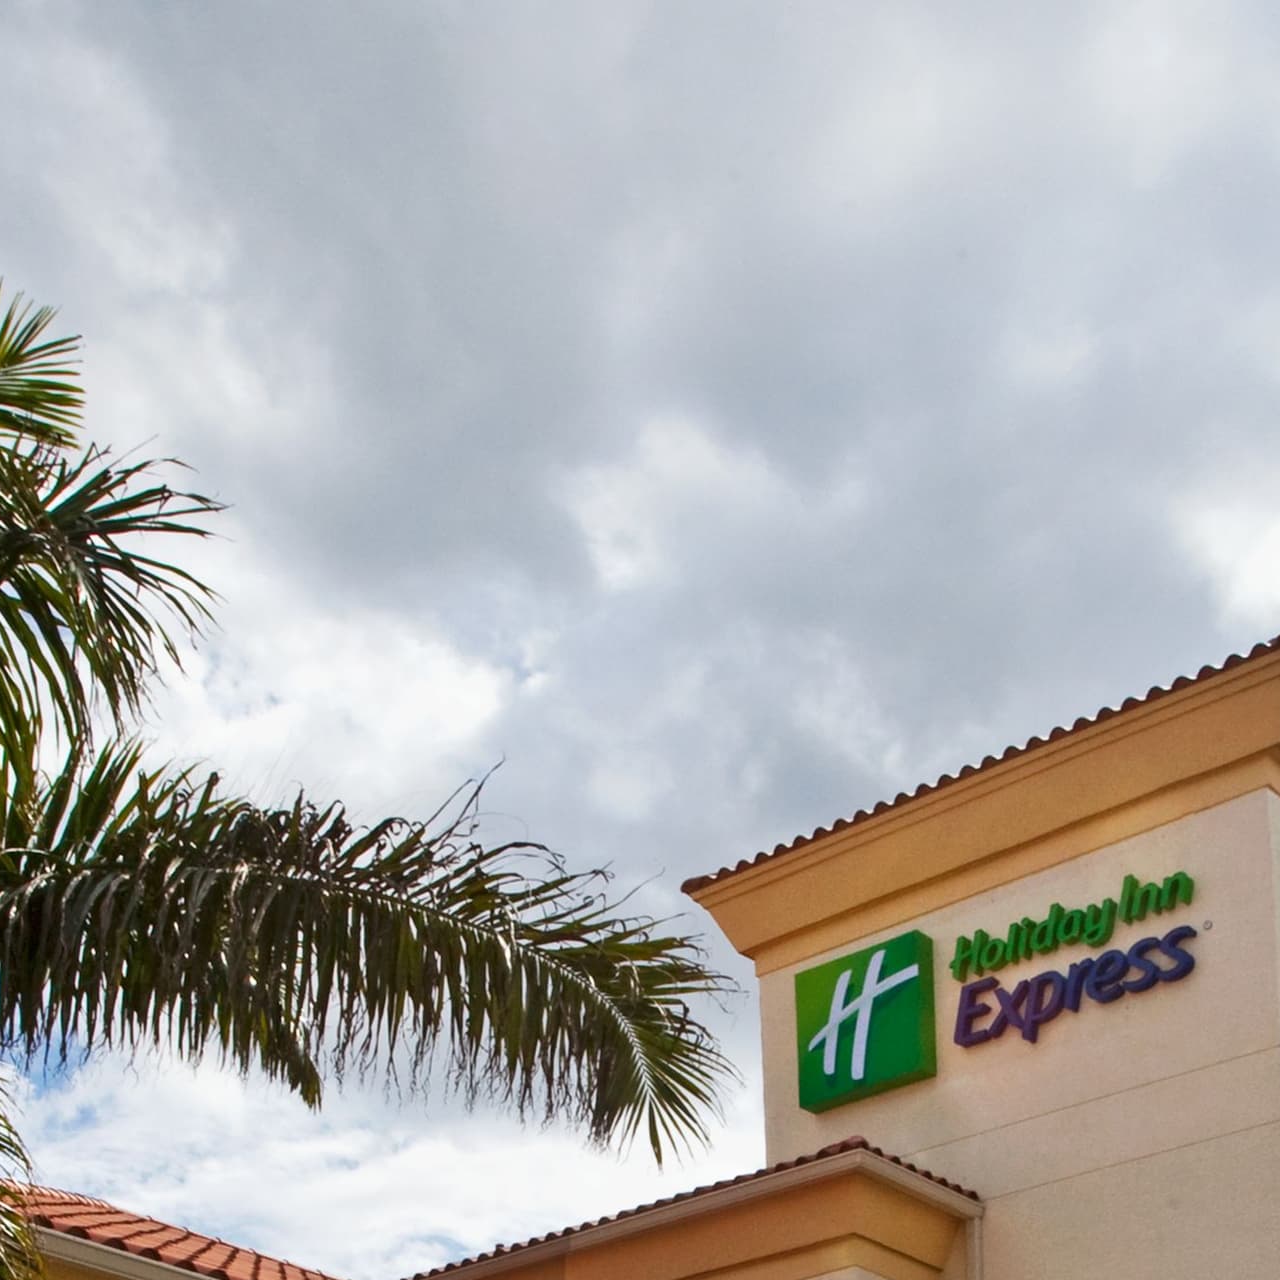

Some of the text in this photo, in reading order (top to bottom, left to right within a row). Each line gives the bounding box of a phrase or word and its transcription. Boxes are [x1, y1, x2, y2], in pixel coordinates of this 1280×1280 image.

[950, 871, 1194, 982] Holiday Inn
[953, 924, 1198, 1048] Express
